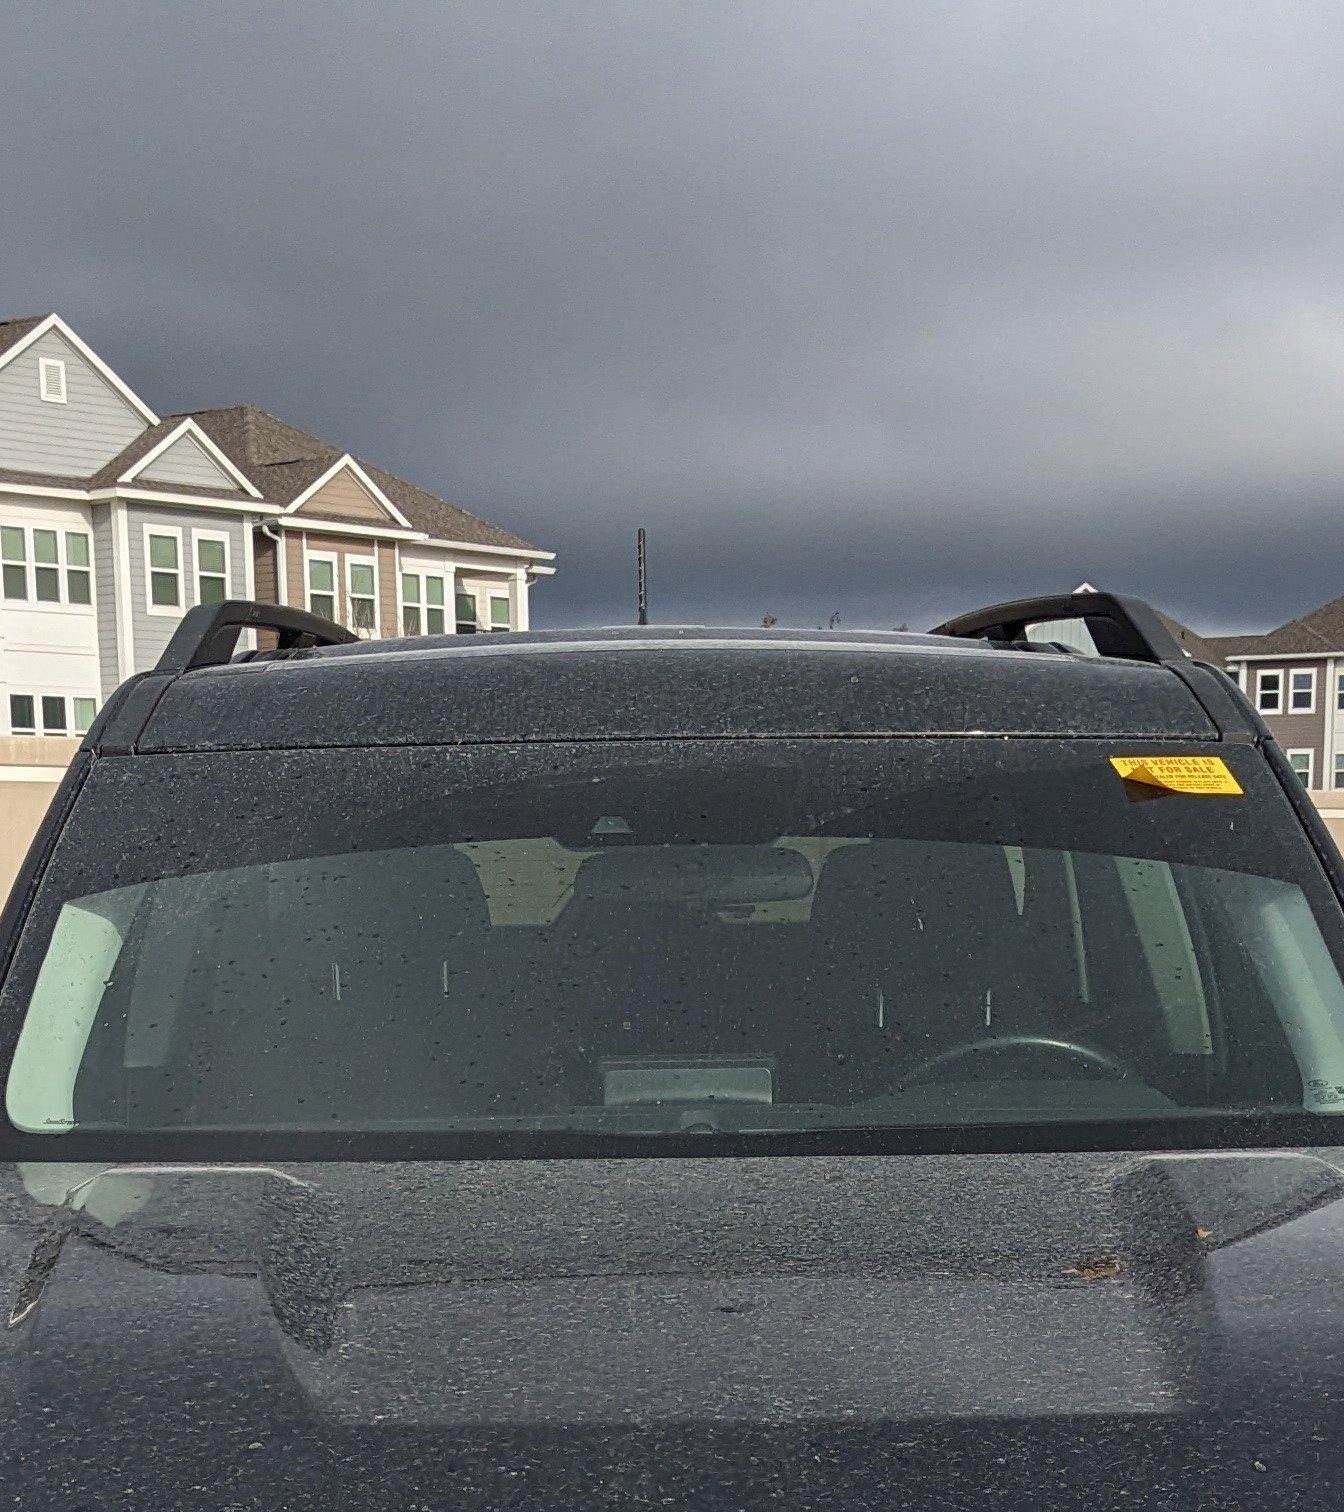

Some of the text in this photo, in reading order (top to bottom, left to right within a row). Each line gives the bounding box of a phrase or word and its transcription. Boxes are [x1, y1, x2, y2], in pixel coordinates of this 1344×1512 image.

[1120, 758, 1216, 766] THIS VEHICLE IS
[1158, 766, 1182, 774] FOR
[1184, 766, 1216, 774] SALE
